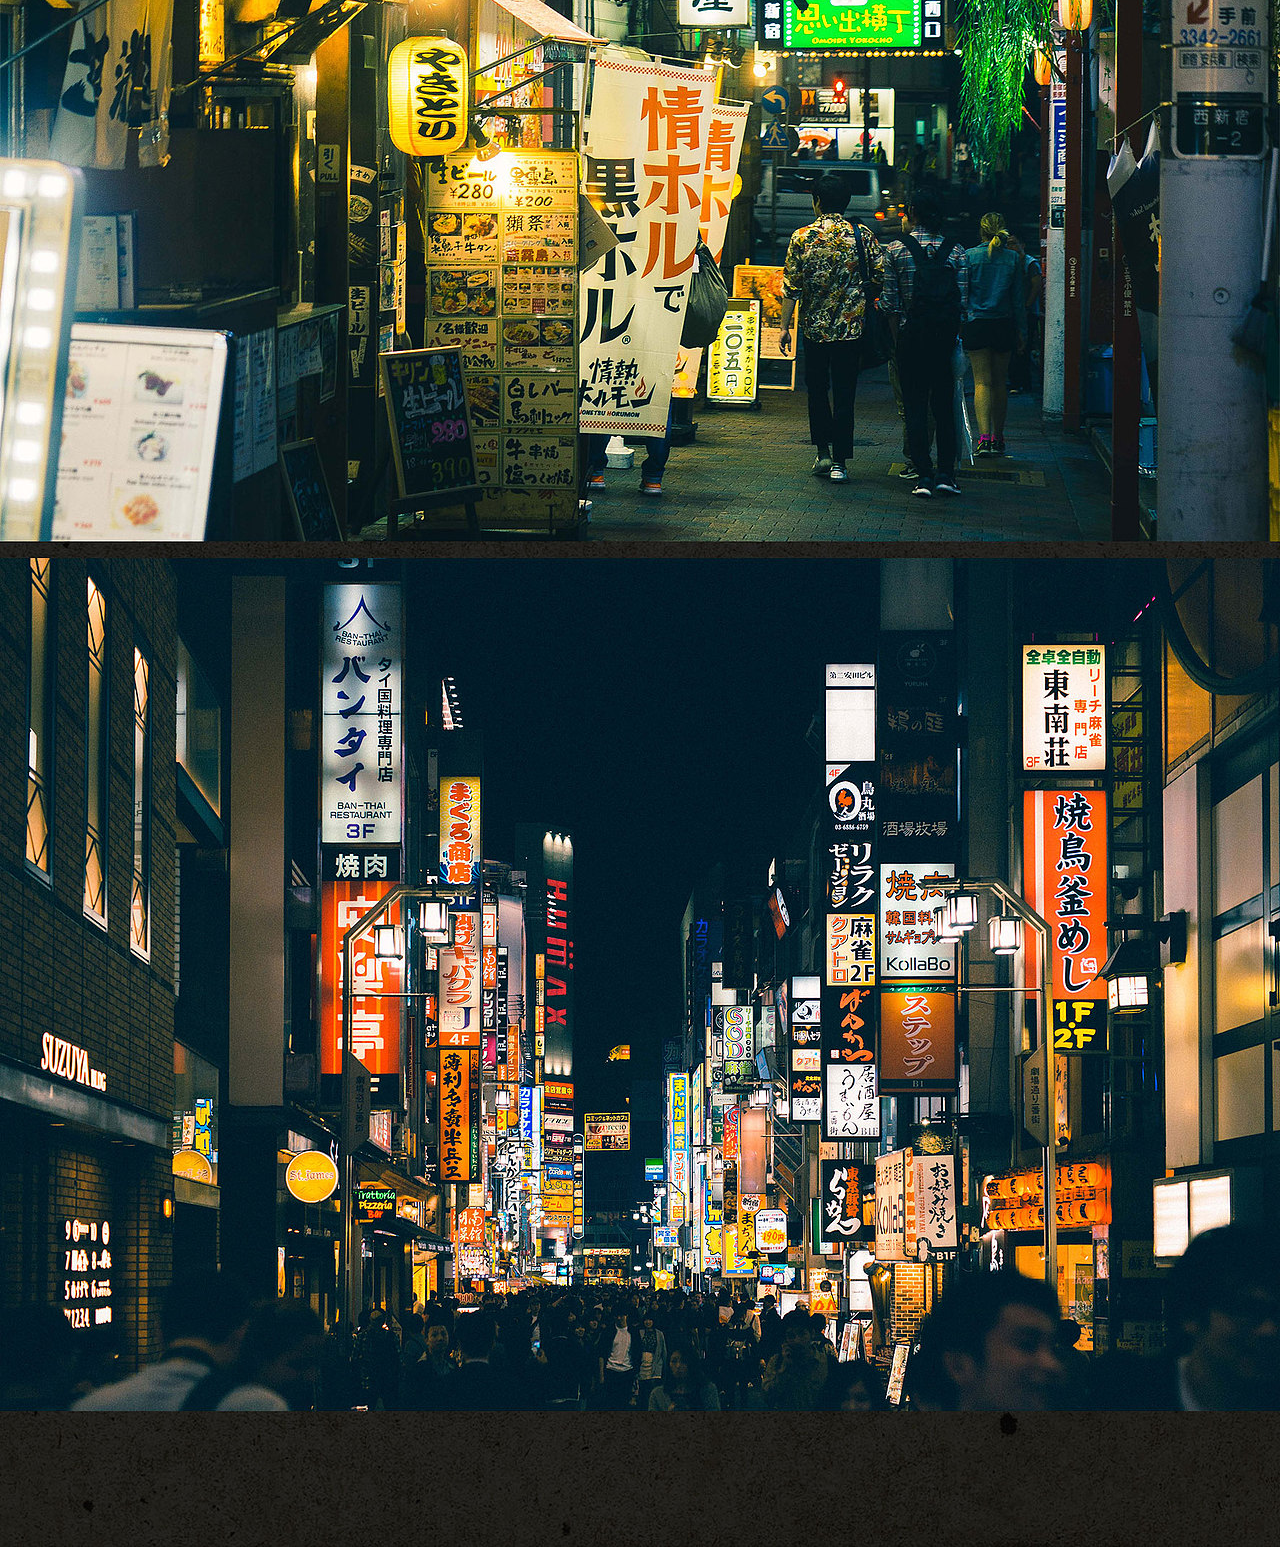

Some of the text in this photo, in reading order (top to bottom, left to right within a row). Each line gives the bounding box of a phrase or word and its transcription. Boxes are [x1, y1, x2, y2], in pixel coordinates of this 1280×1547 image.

[764, 3, 781, 39] 新宿
[795, 4, 911, 35] 思い出横丁
[924, 0, 941, 38] 西口
[1219, 7, 1257, 27] 手前
[1179, 29, 1262, 47] 3342-2661
[415, 48, 461, 141] やきとり
[1193, 108, 1250, 126] 西新宿
[1203, 131, 1242, 148] 1-2
[320, 173, 338, 181] PULL
[430, 162, 497, 185] 生ビール
[449, 183, 494, 200] ¥280
[350, 288, 366, 334] 生ビール
[589, 357, 639, 386] 情熱
[579, 380, 656, 408] ホルモン
[607, 410, 640, 418] HORUMON
[431, 419, 468, 444] 280
[432, 456, 471, 483] 390
[334, 633, 390, 647] RESTAURANT
[341, 630, 382, 640] BAN-THAI
[1026, 650, 1101, 666] 全卓全自動
[1088, 668, 1103, 747] リーチ麻雀
[332, 656, 371, 792] バンタイ
[377, 658, 393, 783] タイ国料理専門店
[1043, 669, 1070, 768] 東南荘
[1074, 699, 1088, 760] 専門店
[828, 768, 841, 777] 4F
[1026, 756, 1040, 768] 3F
[330, 811, 392, 819] RESTAURANT
[337, 802, 386, 810] BAN-THAI
[346, 823, 376, 839] 3F
[448, 781, 473, 884] まぐろ商店
[882, 821, 947, 836] 酒場牧場
[336, 854, 388, 879] 焼肉
[1053, 793, 1094, 994] 焼鳥釜めし
[886, 910, 933, 926] 韓国料
[831, 916, 848, 983] クアトロ
[850, 917, 874, 961] 麻雀
[850, 964, 875, 982] 2F
[886, 957, 951, 972] KollaBo
[483, 990, 495, 1029] レンタル
[1055, 1001, 1095, 1022] 1F
[449, 1033, 470, 1045] 4F
[901, 995, 934, 1077] ステップ
[1054, 1028, 1096, 1049] 2F
[41, 1032, 91, 1087] SUZUYA
[857, 1065, 877, 1121] 居酒屋
[289, 1170, 334, 1181] St.James
[358, 1190, 396, 1200] Trattoria
[359, 1201, 393, 1210] Pizzeria
[927, 1162, 954, 1239] お好み焼き
[367, 1209, 384, 1219] Bar
[936, 1252, 954, 1261] B1F
